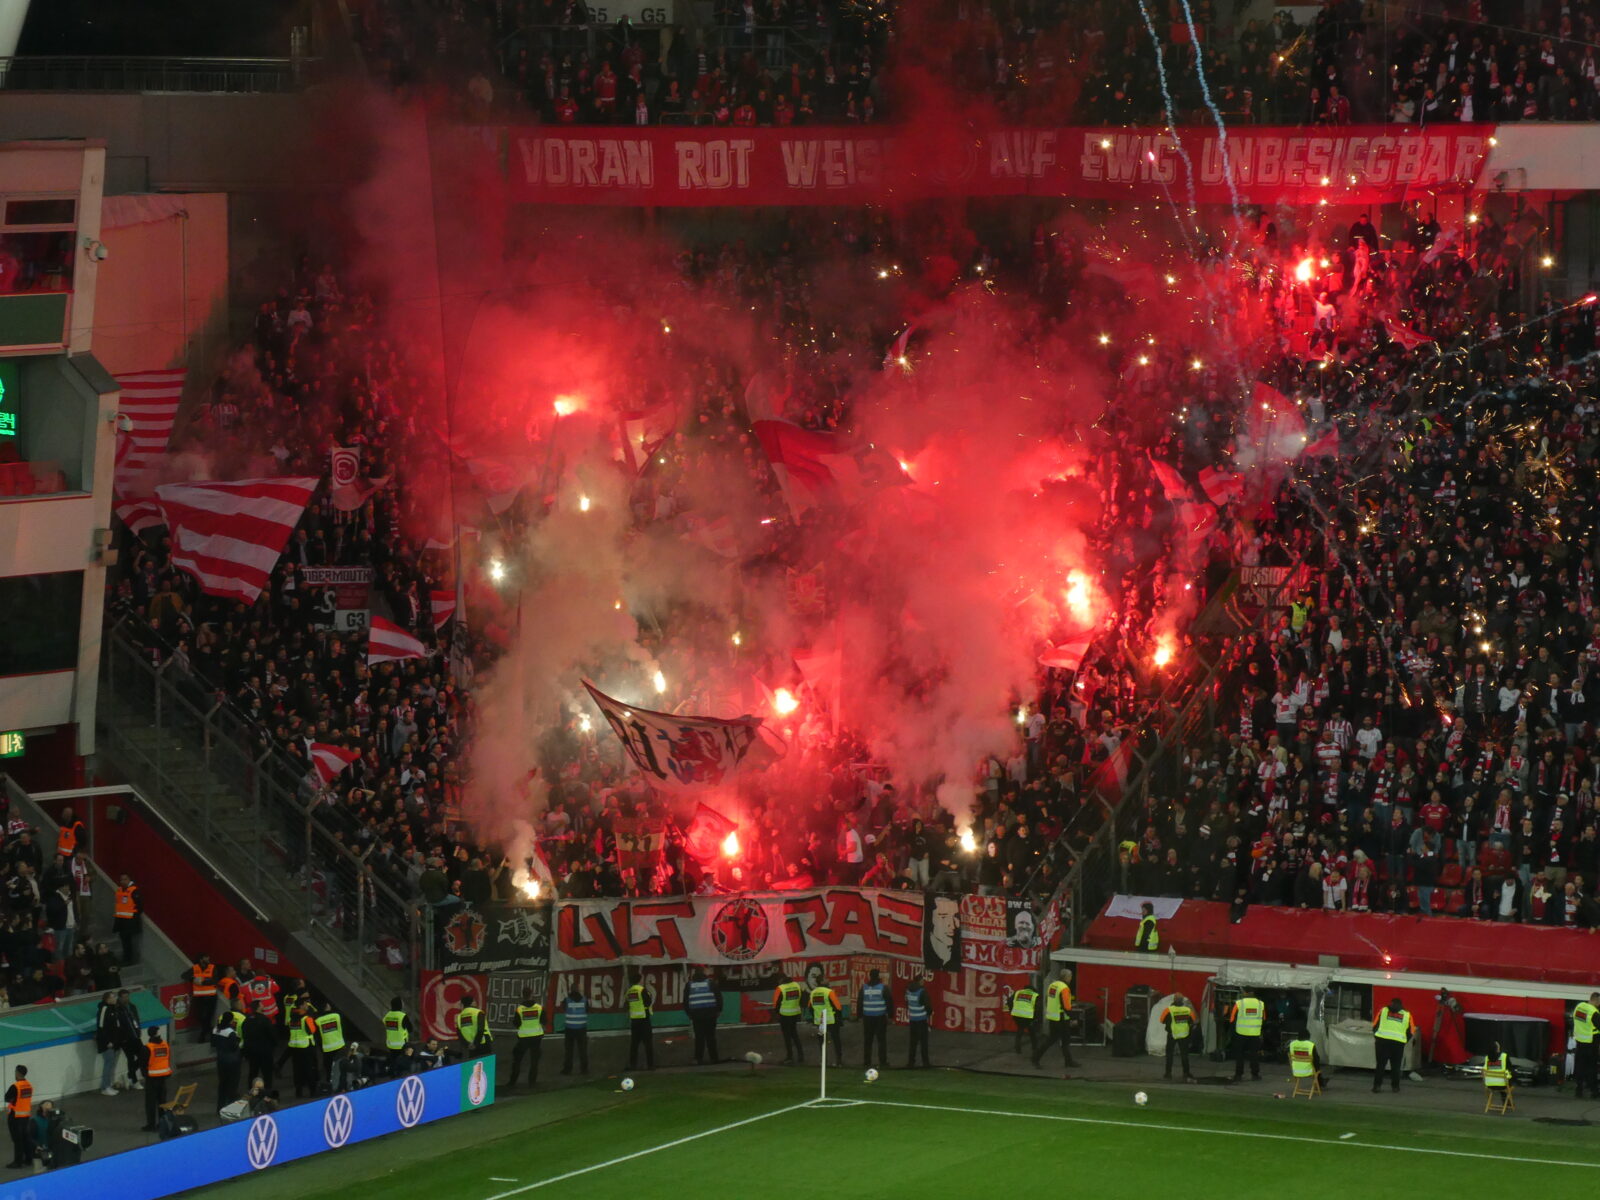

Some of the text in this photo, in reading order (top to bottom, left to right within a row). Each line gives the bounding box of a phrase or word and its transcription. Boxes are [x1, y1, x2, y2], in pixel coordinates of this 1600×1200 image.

[641, 8, 666, 23] G5
[517, 131, 1486, 190] VORAN ROT WEIS AUF EWIG UNBESIEGBAR
[347, 612, 365, 627] G3
[557, 900, 696, 960] ULT
[783, 890, 924, 958] RAS
